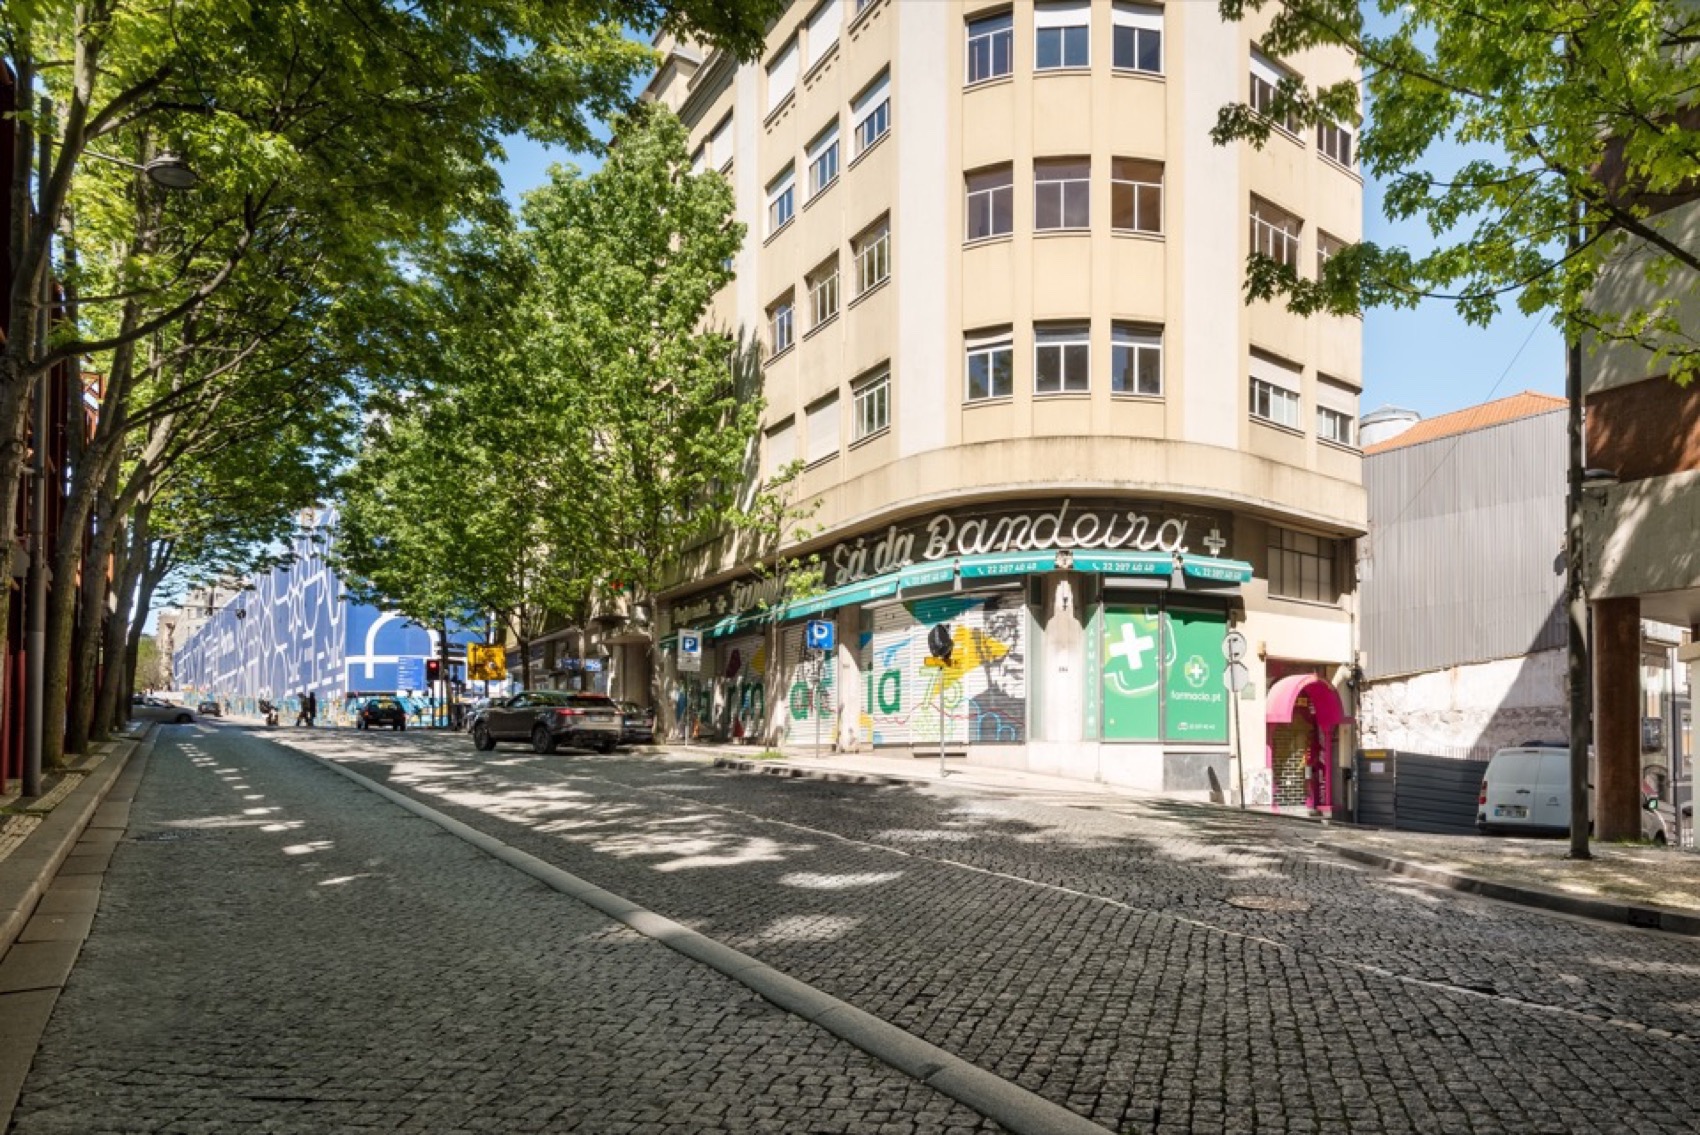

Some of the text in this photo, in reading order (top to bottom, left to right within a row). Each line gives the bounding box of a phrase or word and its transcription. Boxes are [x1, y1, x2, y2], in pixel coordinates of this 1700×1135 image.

[874, 525, 915, 574] da
[922, 498, 1189, 560] Bandeira
[684, 638, 695, 650] P
[814, 624, 829, 646] P
